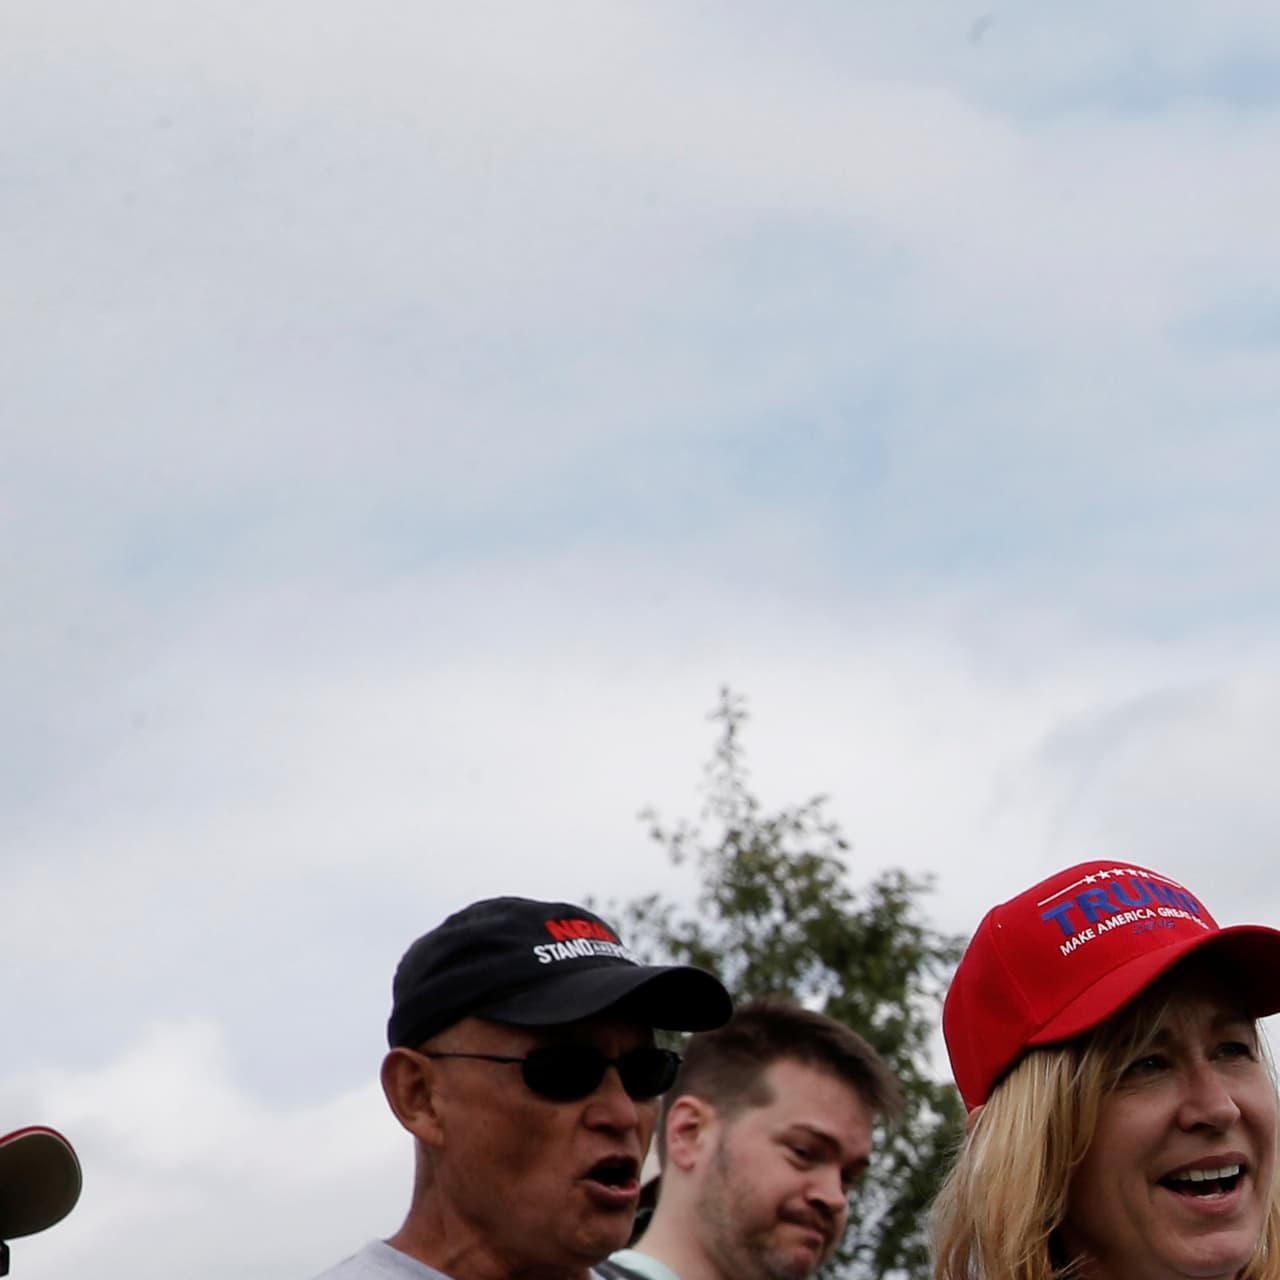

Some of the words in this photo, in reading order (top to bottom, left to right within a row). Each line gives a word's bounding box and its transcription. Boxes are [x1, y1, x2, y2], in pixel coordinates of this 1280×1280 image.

[1041, 879, 1199, 937] TRUMP
[1059, 927, 1097, 956] MAKE
[1097, 907, 1157, 935] AMERICA
[533, 938, 595, 964] STAND
